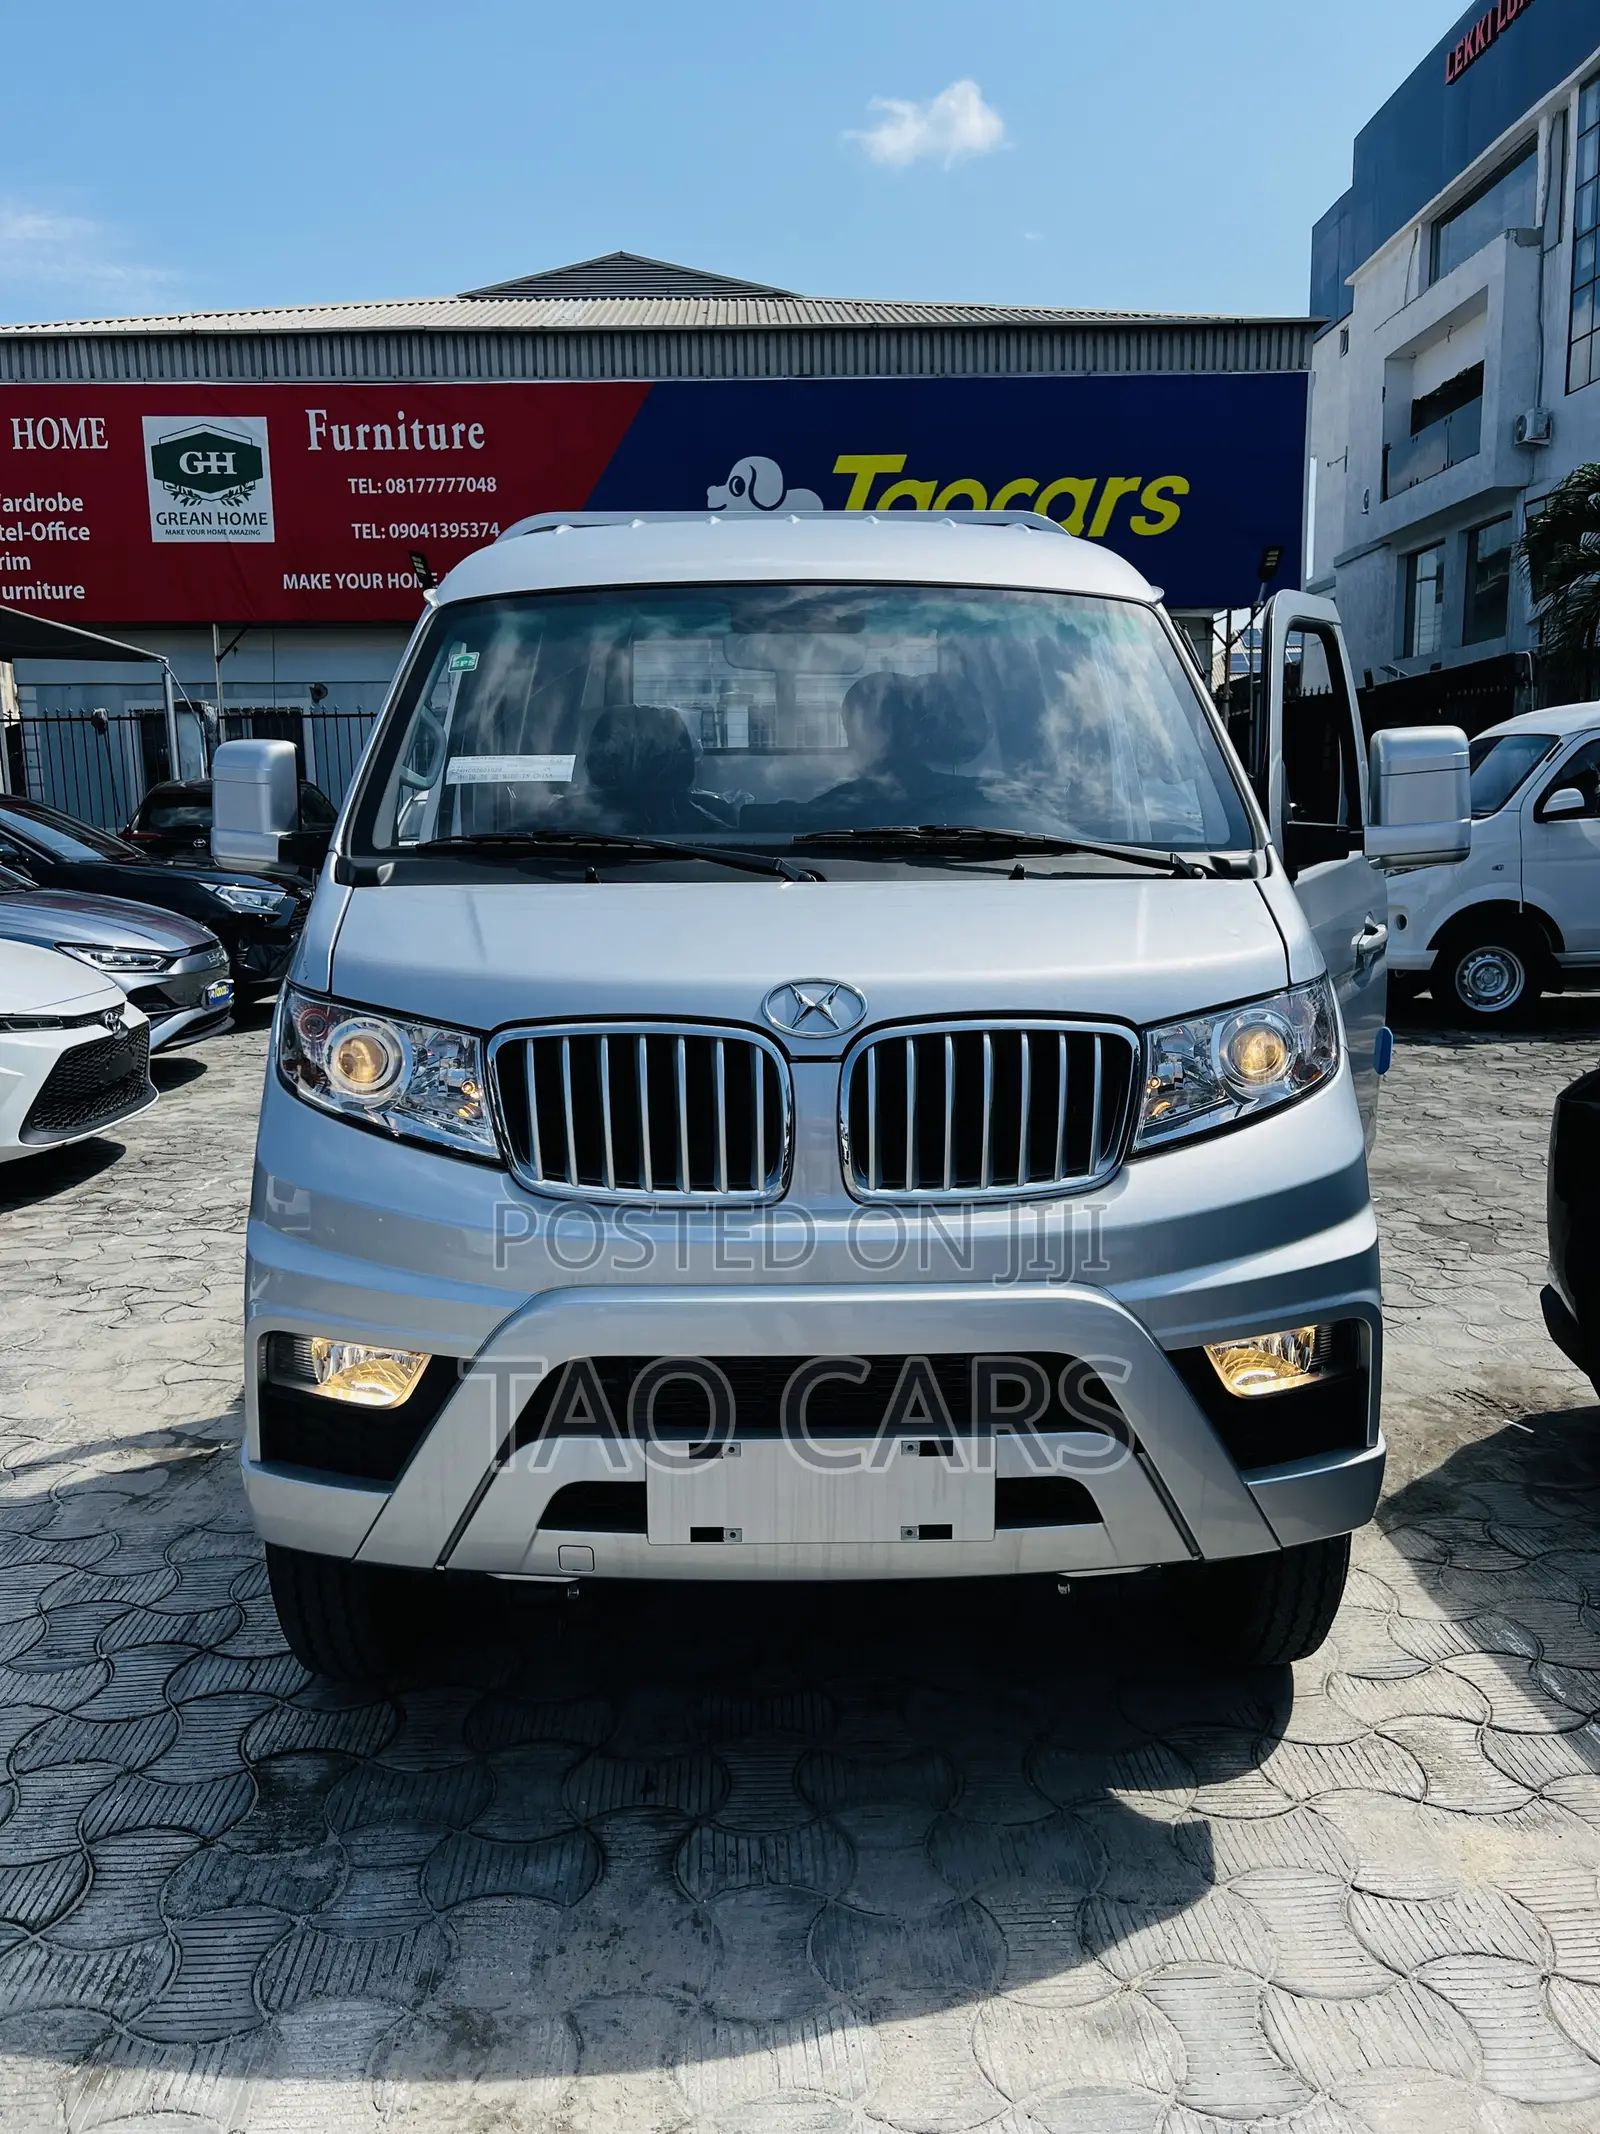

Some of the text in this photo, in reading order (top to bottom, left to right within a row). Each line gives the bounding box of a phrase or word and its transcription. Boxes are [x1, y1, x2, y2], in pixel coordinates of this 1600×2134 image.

[1445, 8, 1494, 85] LEKKI
[10, 416, 109, 450] HOME
[304, 409, 486, 452] Furniture
[178, 450, 238, 475] GH
[347, 476, 498, 494] TEL: 08177777048
[0, 491, 84, 513] ardrobe
[155, 511, 269, 526] GREAN HOME
[164, 528, 261, 536] MAKE YOUR HOME AMAZING
[351, 521, 501, 540] TEL: 09041395374
[282, 573, 332, 590] MAKE
[334, 572, 384, 590] YOUR
